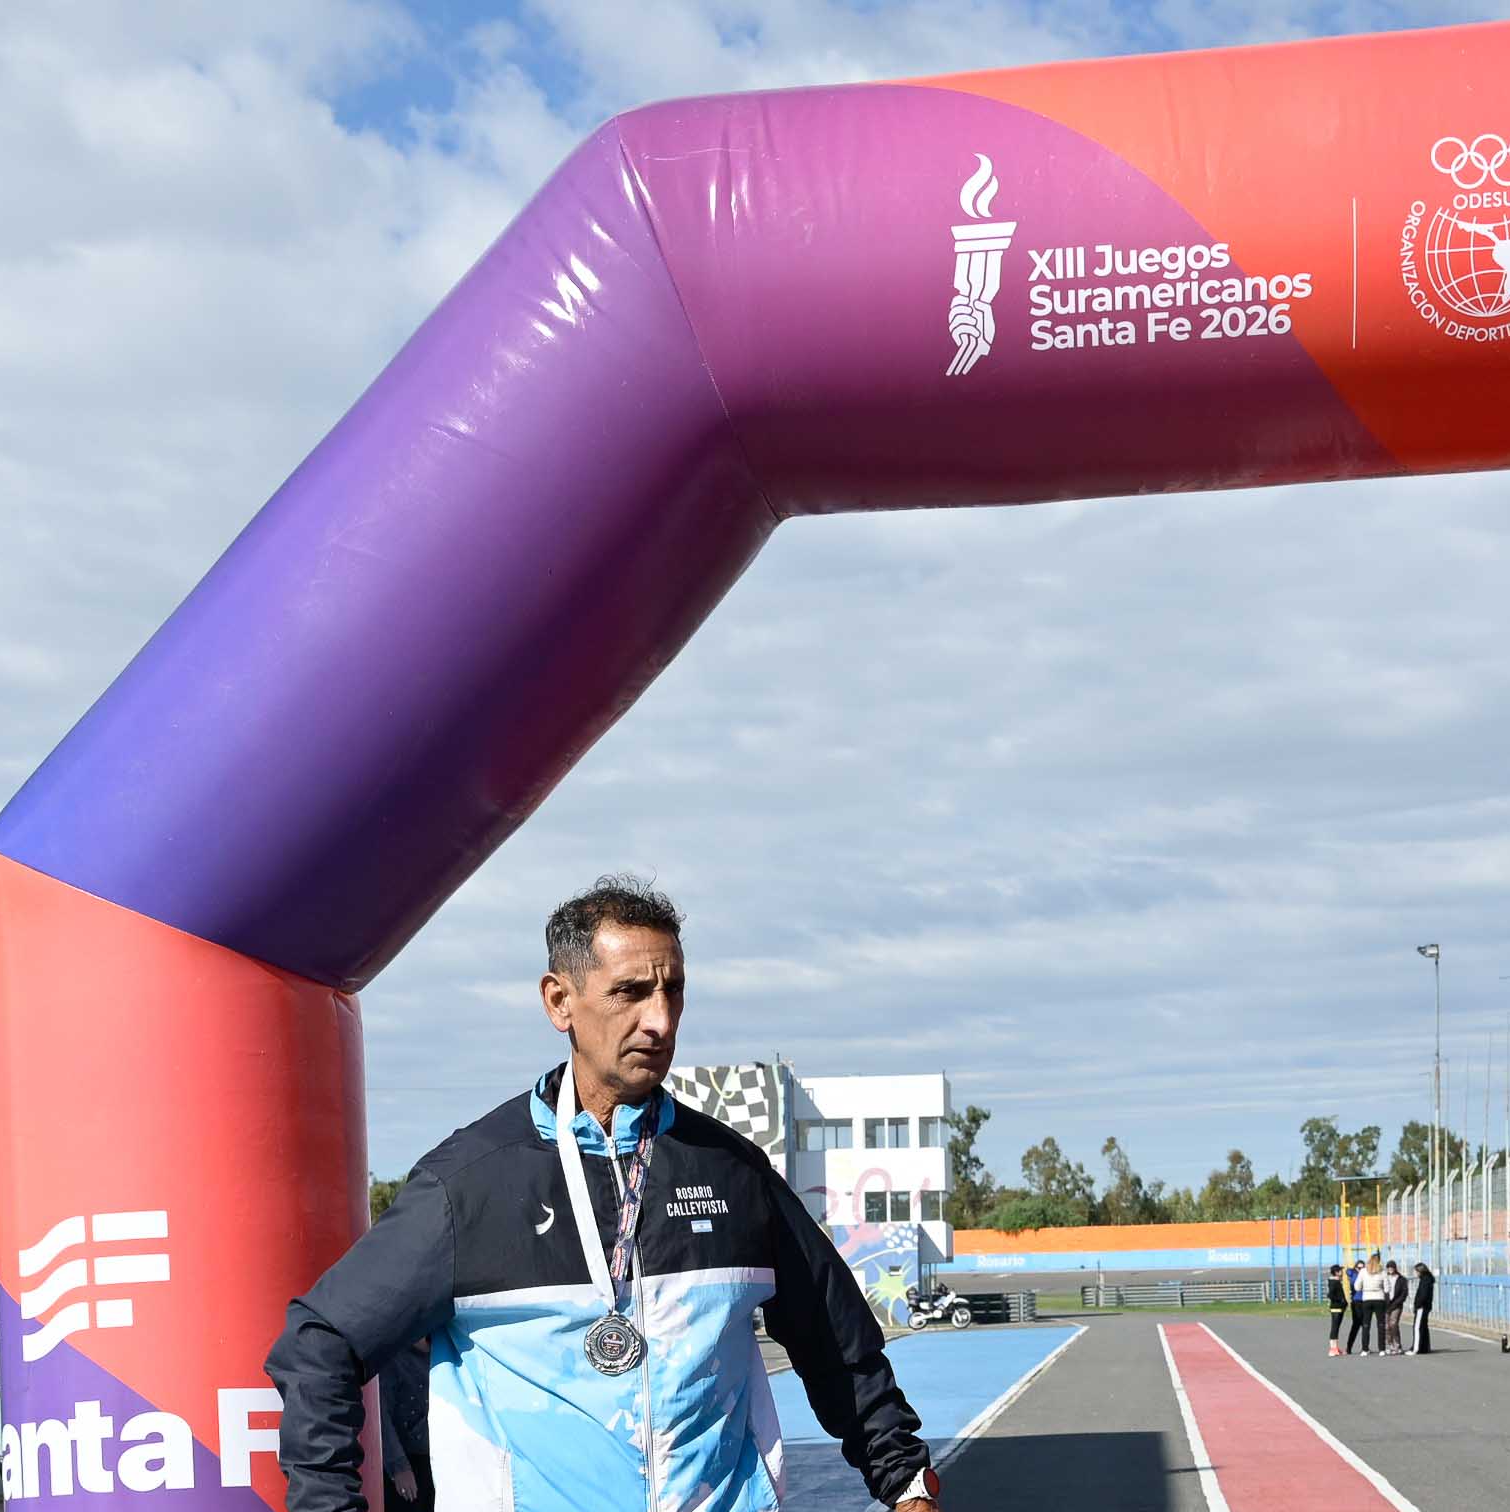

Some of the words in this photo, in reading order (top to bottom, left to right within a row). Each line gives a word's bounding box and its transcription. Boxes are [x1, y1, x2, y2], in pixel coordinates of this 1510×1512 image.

[1027, 246, 1086, 282] XIII
[1093, 242, 1231, 280] Juegos
[1399, 200, 1447, 330] ORGANIZACION
[1029, 270, 1313, 317] Suramericanos
[1030, 315, 1136, 351] Santa
[1146, 311, 1192, 343] Fe
[1199, 302, 1292, 340] 2026
[666, 1199, 729, 1217] CALLEYPISTA
[675, 1185, 713, 1201] ROSARIO
[1, 1400, 195, 1501] anta
[216, 1387, 285, 1488] F
